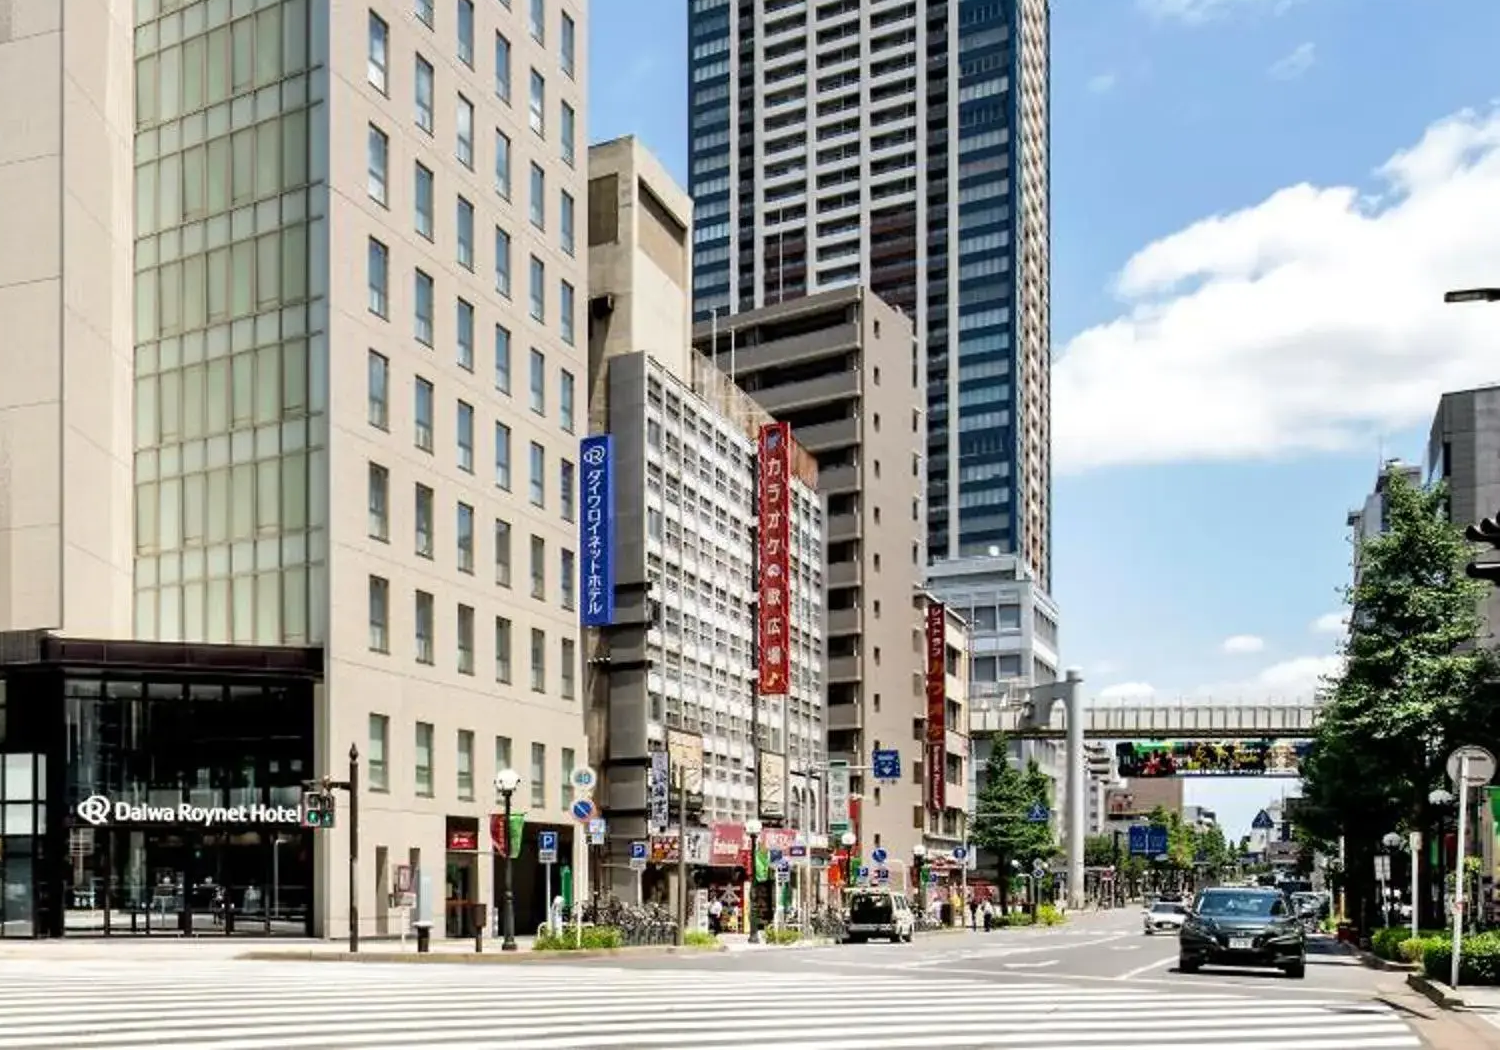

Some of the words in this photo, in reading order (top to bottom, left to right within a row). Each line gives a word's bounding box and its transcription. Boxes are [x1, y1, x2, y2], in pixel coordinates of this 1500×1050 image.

[587, 469, 604, 615] ダイワロイネットホテル
[115, 801, 174, 822] Daiwa
[178, 803, 247, 826] Roynet
[251, 803, 300, 822] Hotel
[543, 835, 553, 850] P
[634, 845, 643, 857] P
